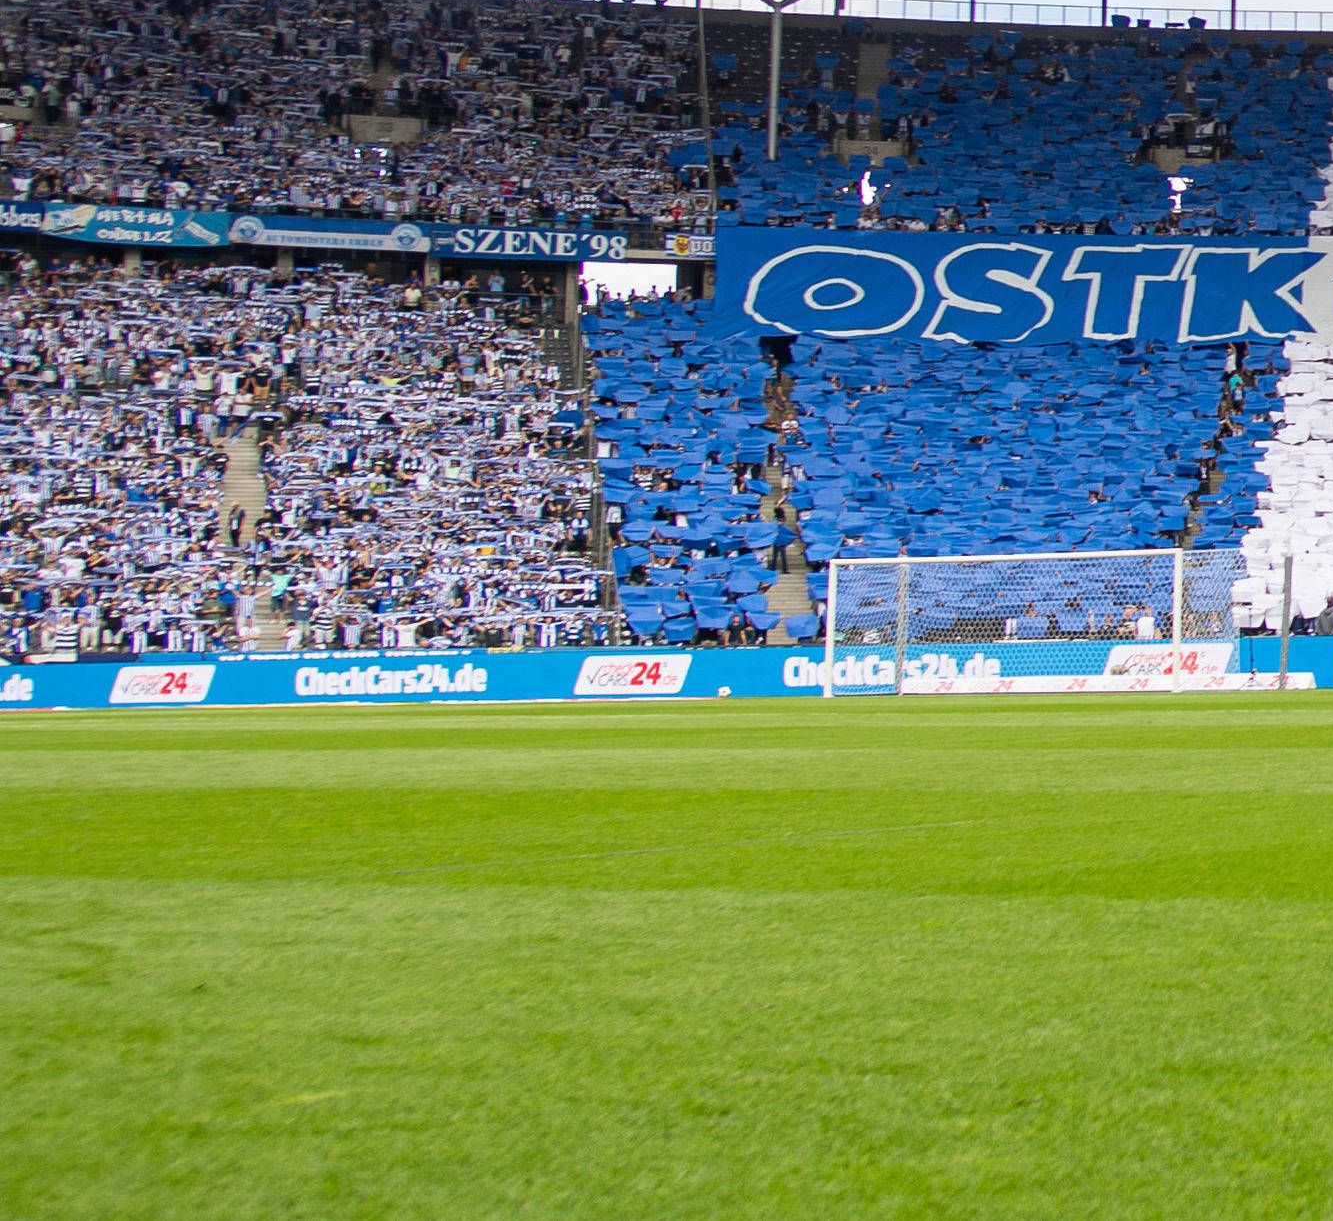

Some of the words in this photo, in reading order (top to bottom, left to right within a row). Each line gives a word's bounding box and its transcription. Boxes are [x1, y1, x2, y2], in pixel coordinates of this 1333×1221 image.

[160, 672, 188, 695] 24
[295, 663, 488, 696] CheckCars24.de
[630, 661, 662, 686] 24
